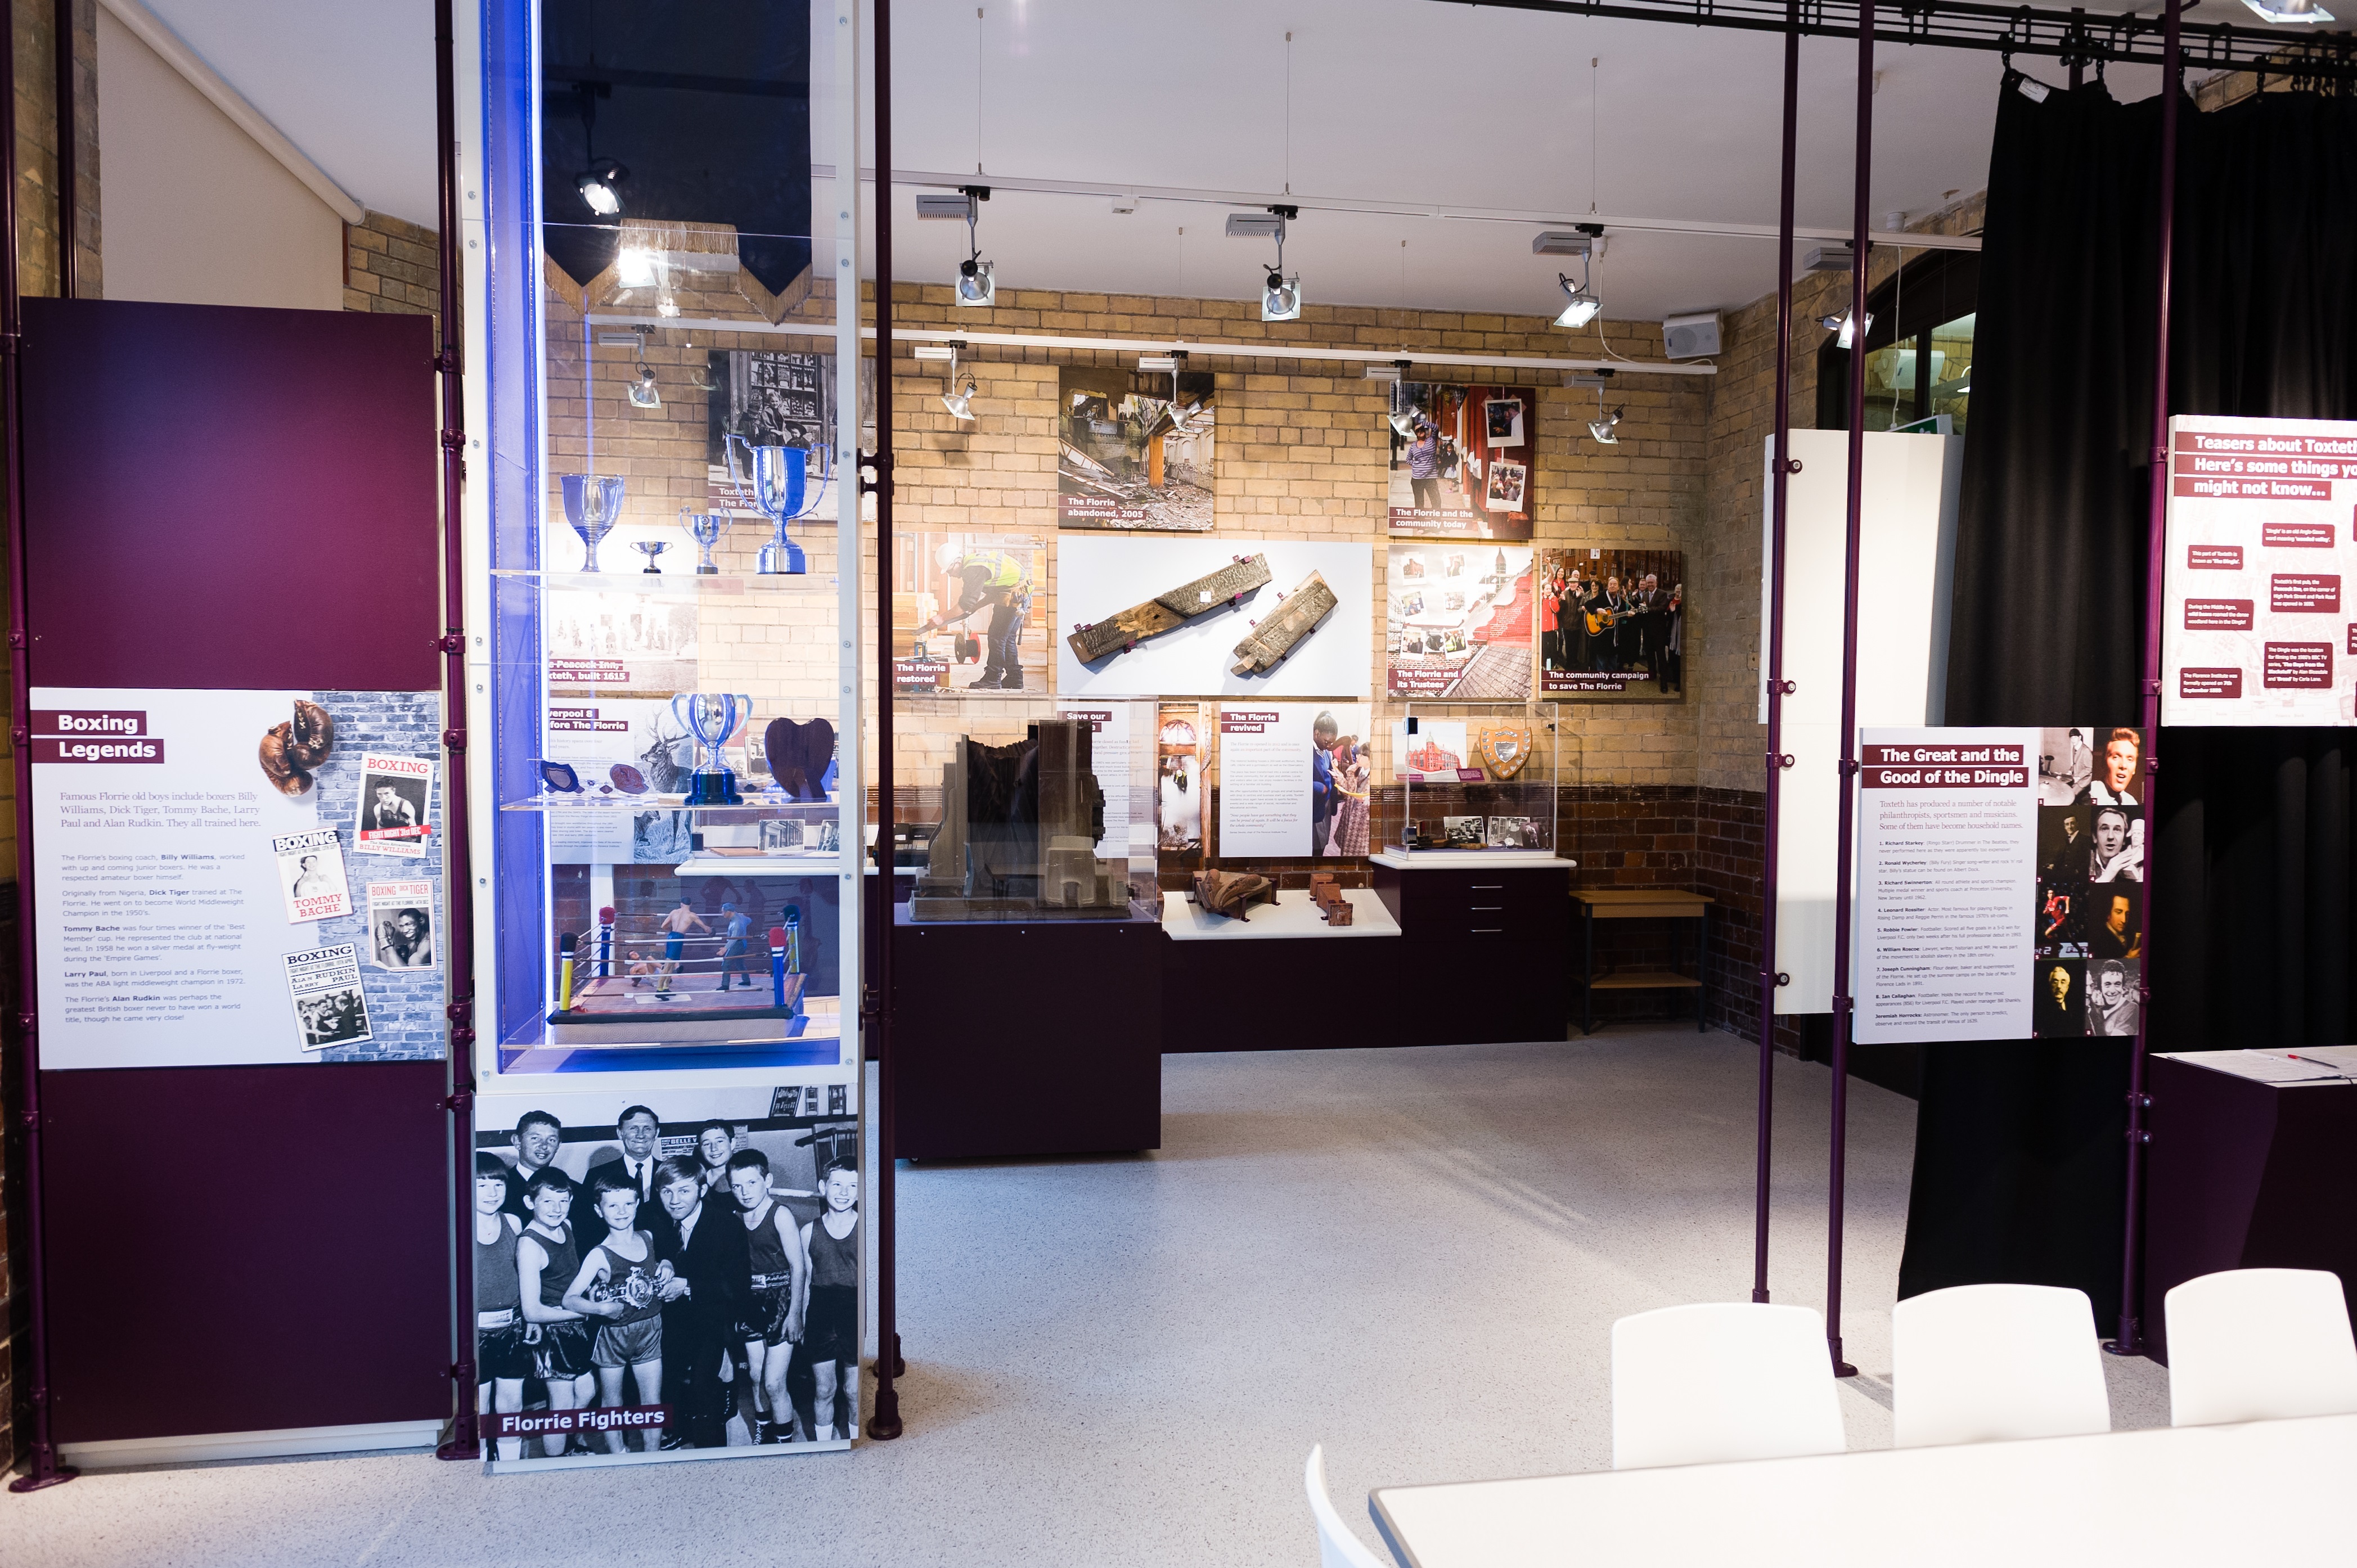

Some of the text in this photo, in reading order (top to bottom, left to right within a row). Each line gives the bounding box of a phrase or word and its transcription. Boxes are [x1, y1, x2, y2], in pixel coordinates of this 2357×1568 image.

[2194, 435, 2255, 450] Teasers
[2257, 437, 2302, 452] about
[2194, 457, 2357, 478] Here's some things yo
[2194, 480, 2326, 497] might not know...
[1068, 509, 1118, 518] abandoned,
[1396, 519, 1467, 529] community today
[556, 660, 596, 669] Peacock
[599, 661, 619, 670] Inn,
[549, 672, 626, 681] teth, built 1615
[1611, 672, 1649, 680] campaign
[549, 710, 584, 719] erpool
[1229, 713, 1276, 721] The Florrie
[58, 714, 138, 735] Boxing
[1230, 723, 1262, 732] revived
[59, 741, 156, 760] Legends
[1880, 747, 2019, 762] The Great and the
[367, 758, 428, 773] BOXING
[1879, 769, 2023, 785] Good of the Dingle
[60, 791, 258, 802] Famous Florrie old boys include boxers Billy
[60, 805, 260, 815] Williams, Dick Tiger, Tommy Bache, Larry
[1919, 799, 1950, 809] produced
[1879, 810, 1931, 821] philanthropists,
[60, 818, 260, 828] Paul and Alan Rudkin. They all trained here.
[368, 830, 384, 840] FIGHT
[384, 829, 400, 838] NIGHT
[411, 827, 421, 835] DEC
[275, 831, 338, 851] BOXING
[383, 846, 420, 854] WILLIAMS
[372, 886, 396, 896] BOXING
[410, 884, 429, 894] TIGER
[293, 893, 342, 908] TOMMY
[299, 903, 340, 917] BACHE
[287, 946, 352, 965] BOXING
[315, 967, 356, 979] RUDKIN
[332, 974, 358, 983] PAUL
[502, 1411, 664, 1431] Florrie Fighters
